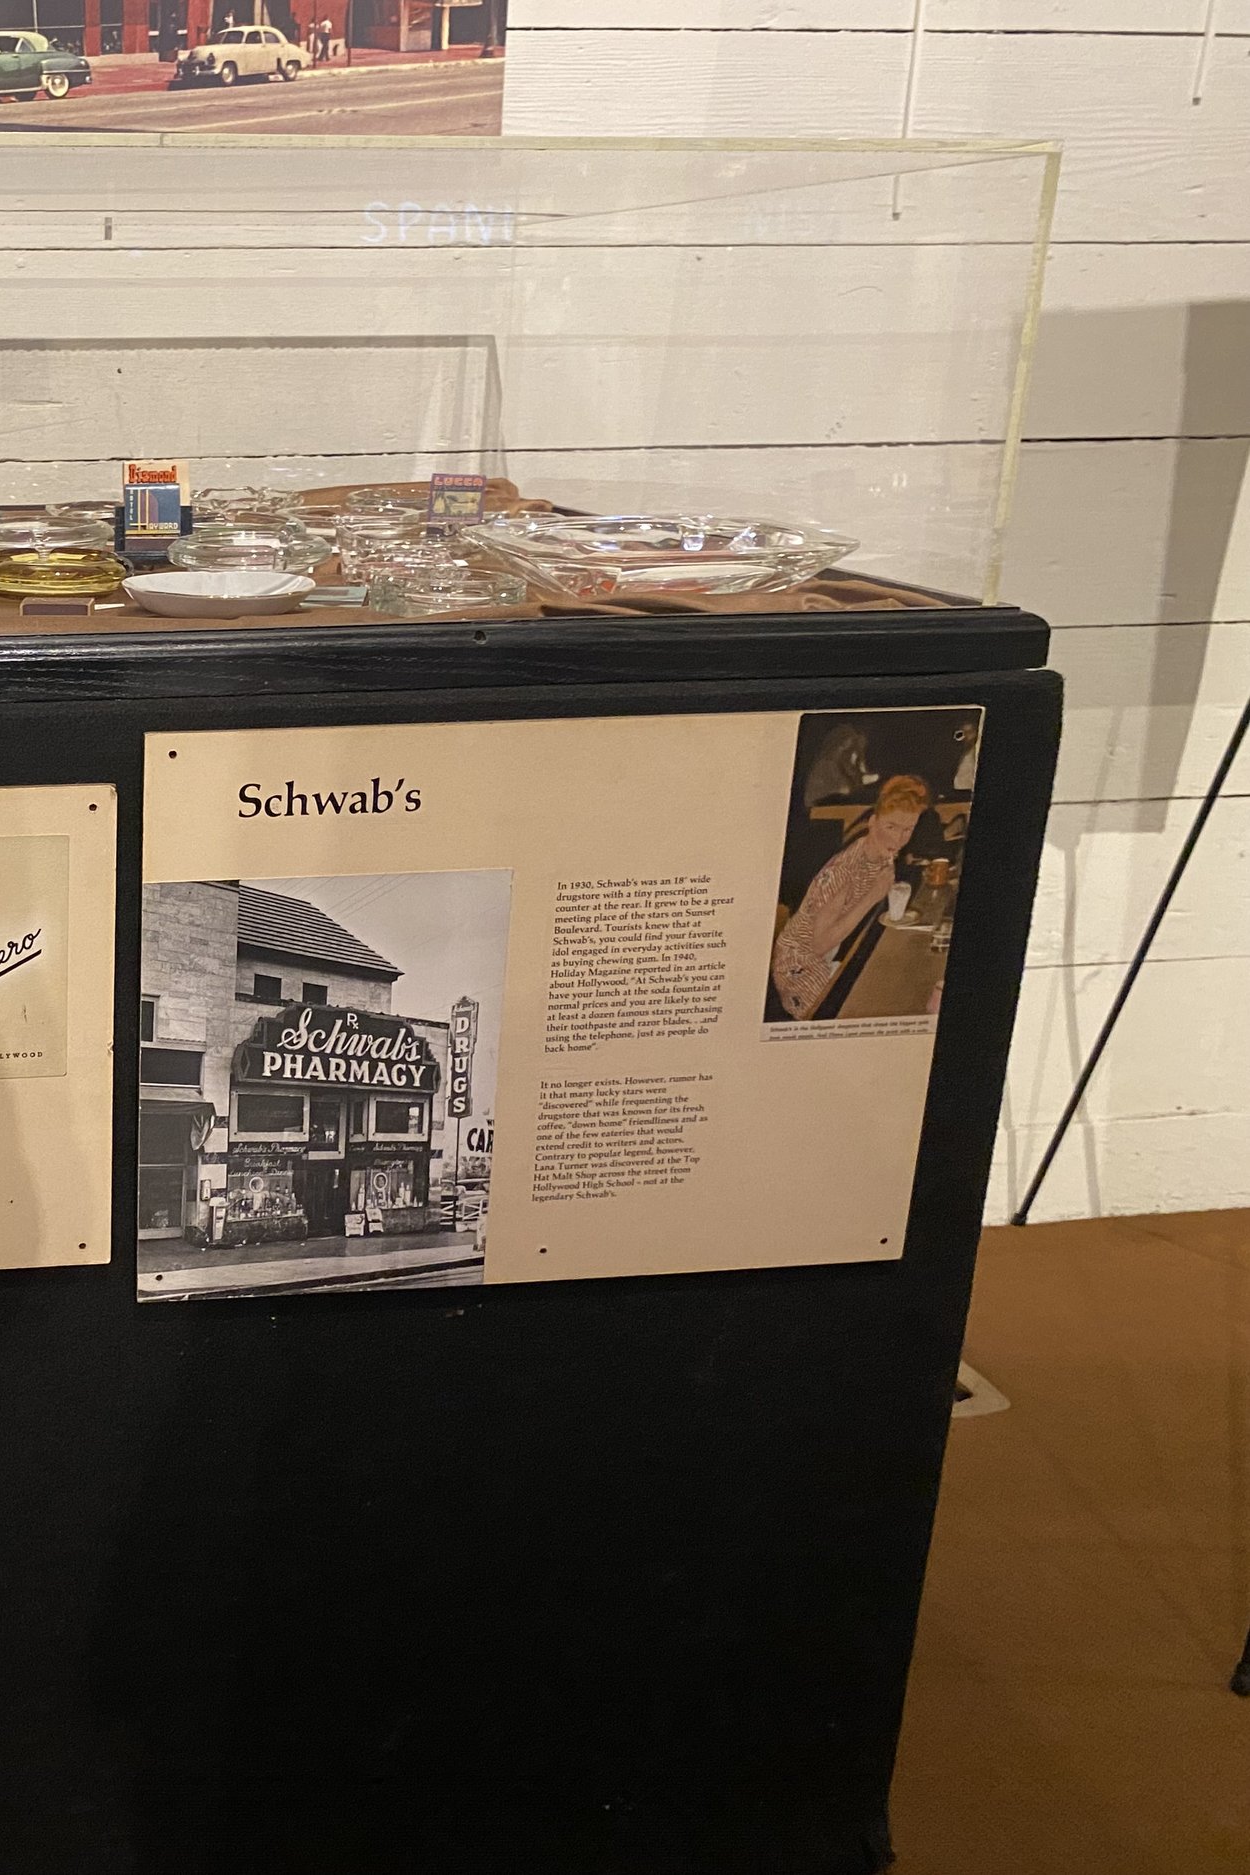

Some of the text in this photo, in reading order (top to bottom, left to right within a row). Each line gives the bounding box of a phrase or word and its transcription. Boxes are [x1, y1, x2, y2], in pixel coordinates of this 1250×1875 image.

[238, 777, 422, 818] Schwab's
[277, 1008, 421, 1062] Schwab's
[262, 1051, 426, 1087] PHARMACY
[453, 1017, 470, 1113] DRUGS
